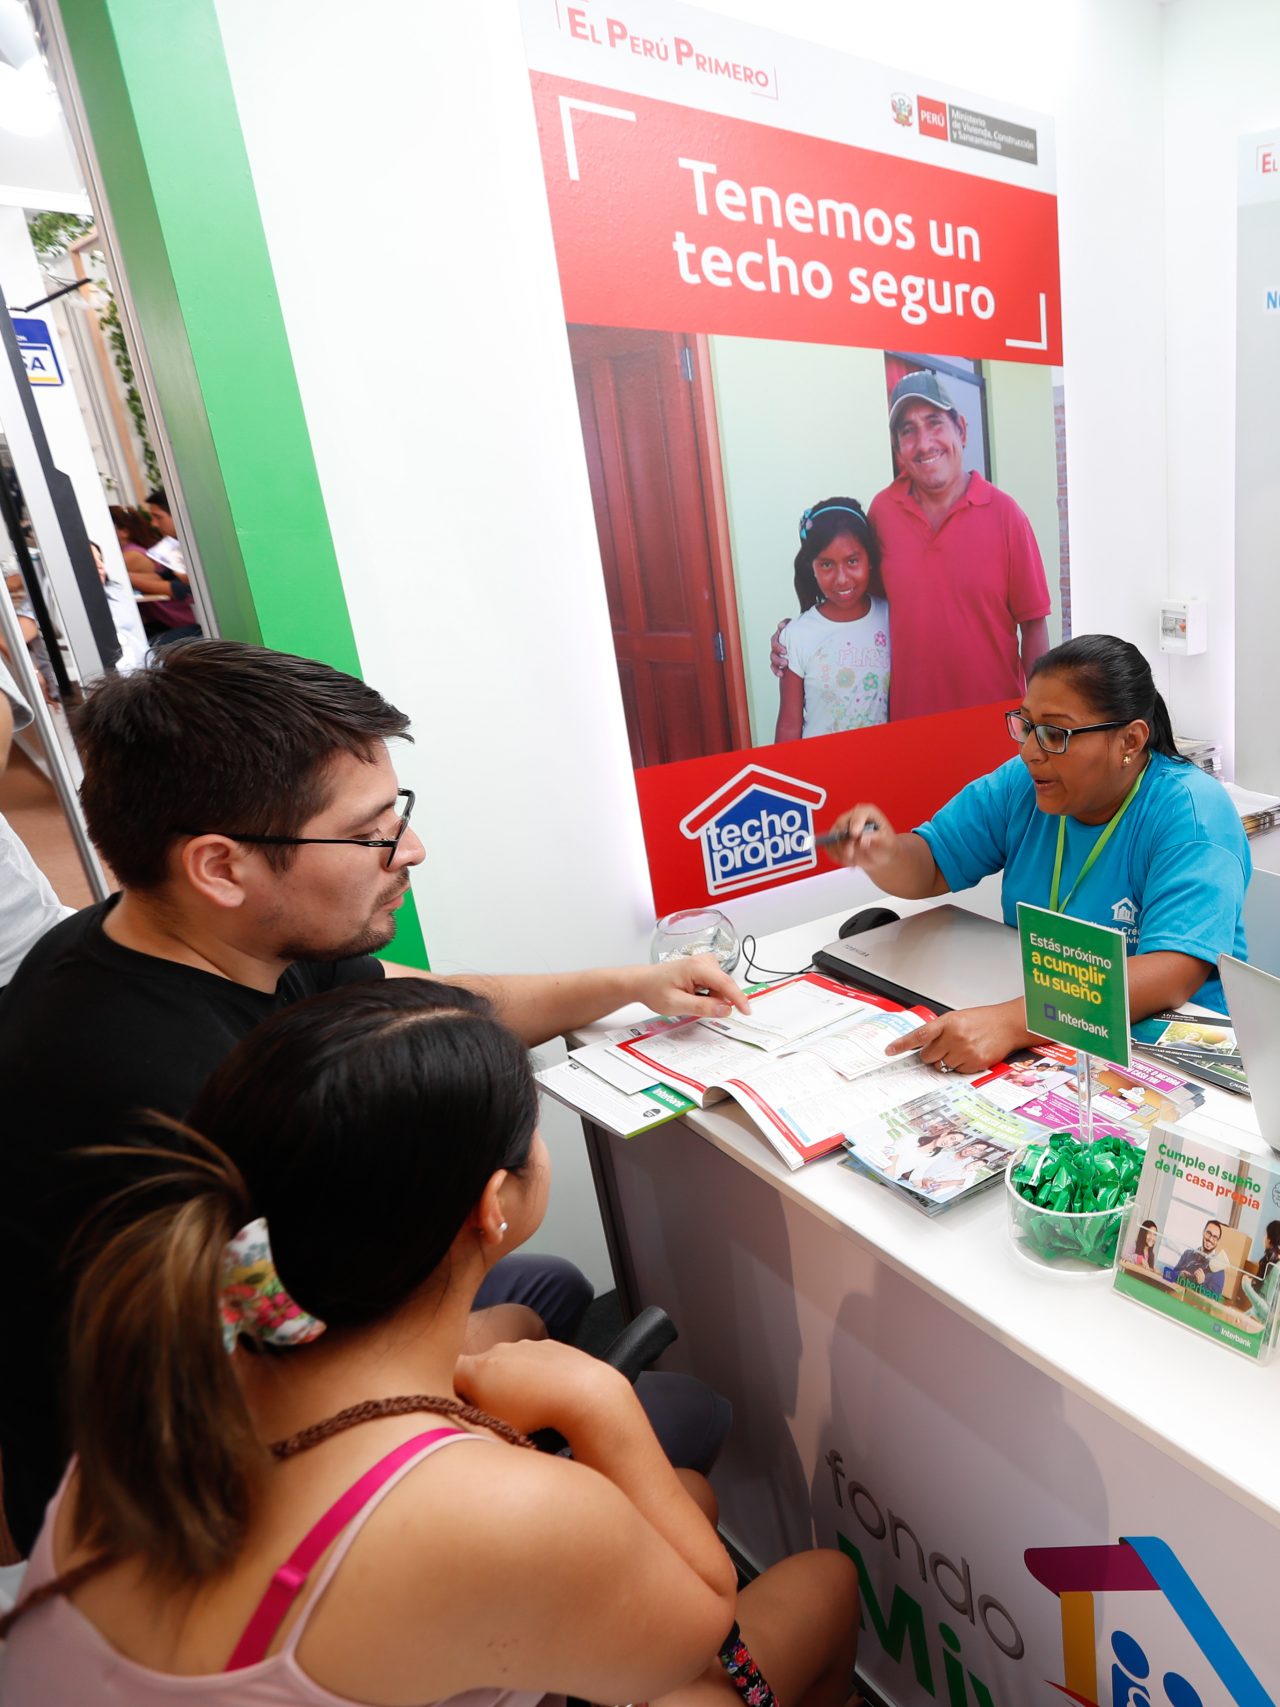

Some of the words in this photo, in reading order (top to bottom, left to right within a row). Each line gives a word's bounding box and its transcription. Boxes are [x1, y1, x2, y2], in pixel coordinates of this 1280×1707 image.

[567, 7, 602, 45] EL
[606, 17, 669, 61] PERÚ
[673, 36, 769, 87] PRIMERO
[920, 110, 945, 127] PERÚ
[951, 108, 986, 127] Ministerio
[952, 119, 961, 129] de
[993, 130, 1034, 150] Construcción
[958, 130, 1002, 150] Saneamiento
[1261, 152, 1279, 174] EL
[678, 157, 915, 250] Tenemos
[929, 222, 981, 262] un
[673, 229, 833, 300] techo
[849, 266, 996, 325] seguro
[707, 809, 802, 852] techo
[712, 829, 810, 881] propio
[1029, 932, 1061, 954] Estás
[1062, 943, 1113, 970] próximo
[1031, 951, 1042, 964] a
[1043, 956, 1107, 987] cumplir
[1032, 967, 1050, 987] tu
[1052, 976, 1102, 1006] sueño
[1058, 1009, 1110, 1039] Interbank
[1154, 1158, 1171, 1174] de
[1172, 1163, 1184, 1179] la
[1185, 1172, 1214, 1192] casa
[1215, 1182, 1261, 1211] propia
[1157, 1142, 1206, 1172] Cumple
[1207, 1164, 1220, 1178] el
[1221, 1169, 1262, 1194] sueño
[1220, 1327, 1252, 1348] Interbank
[824, 1447, 1026, 1662] fondo
